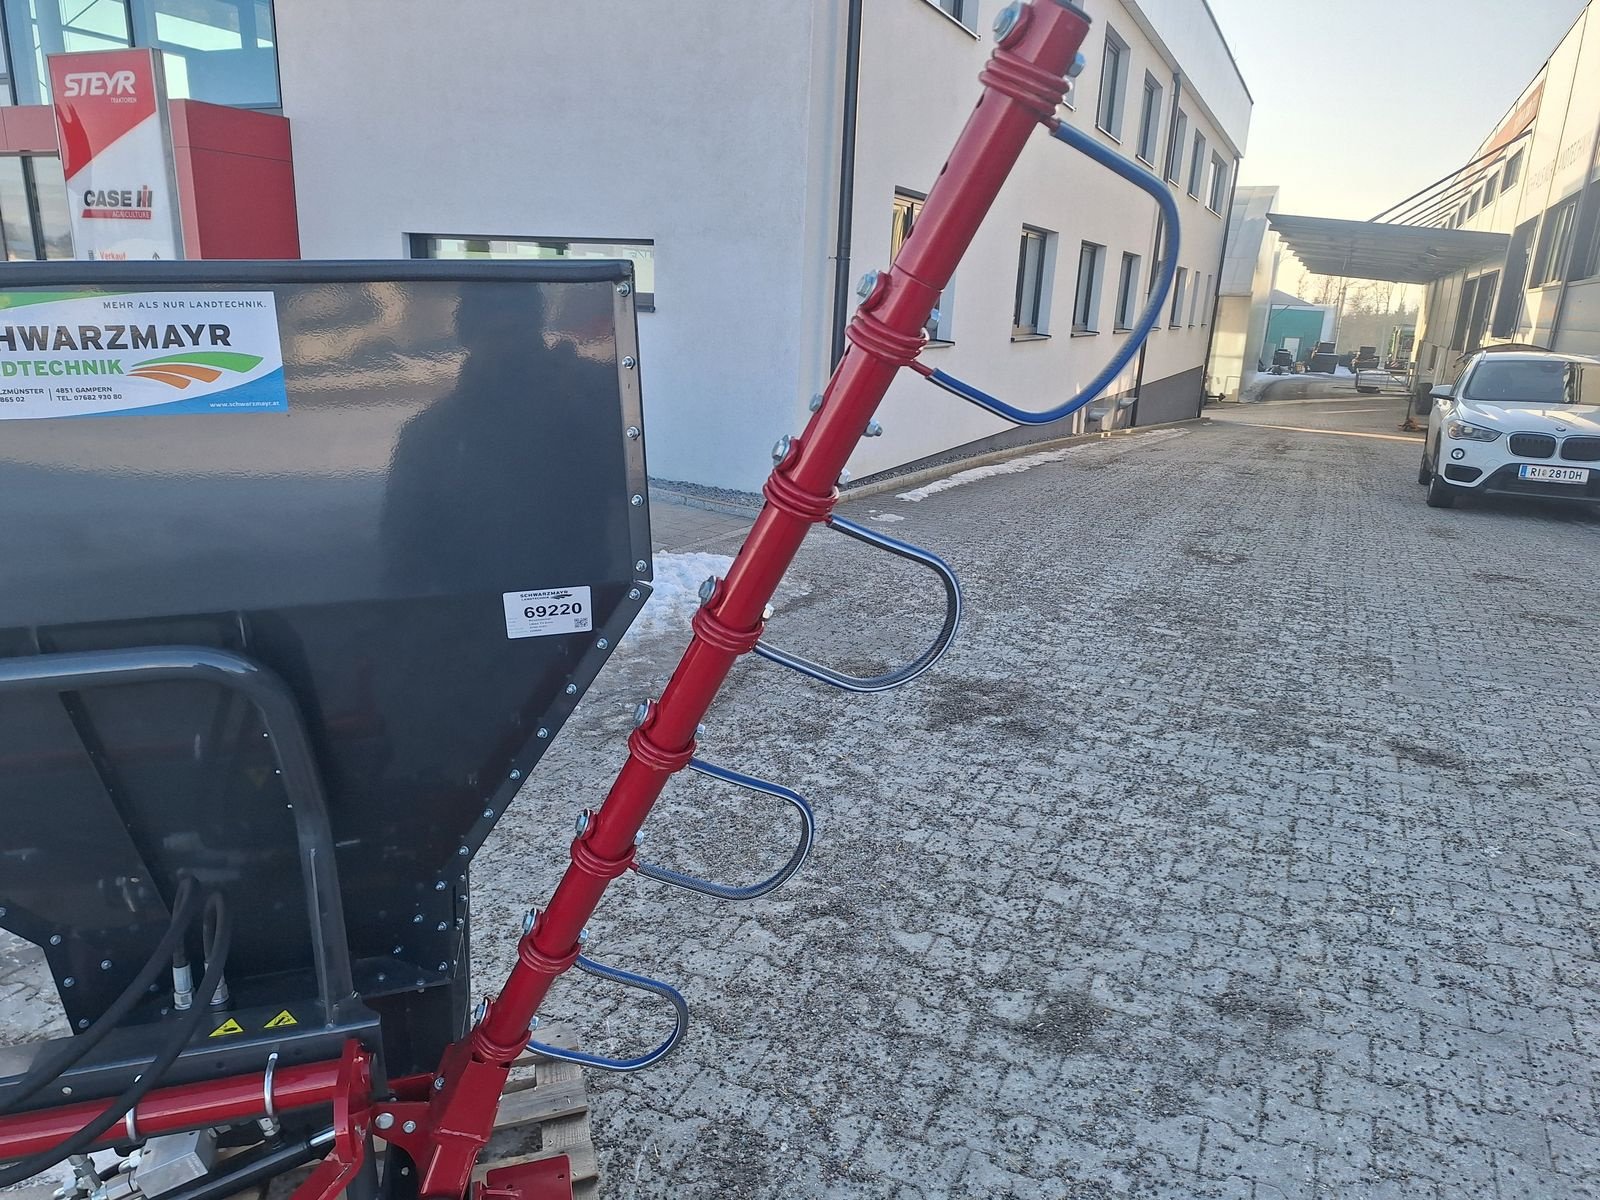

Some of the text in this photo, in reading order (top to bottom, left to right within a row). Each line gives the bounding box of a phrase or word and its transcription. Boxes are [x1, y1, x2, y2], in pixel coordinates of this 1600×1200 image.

[64, 71, 135, 97] STEYR
[83, 190, 132, 207] CASE
[103, 300, 268, 309] MEHR ALS NUR LANDTECHNIK.
[75, 386, 113, 394] GAMPERN
[209, 400, 280, 408] www.schwarzmayr.at
[1530, 467, 1541, 477] RI
[524, 603, 582, 618] 69220
